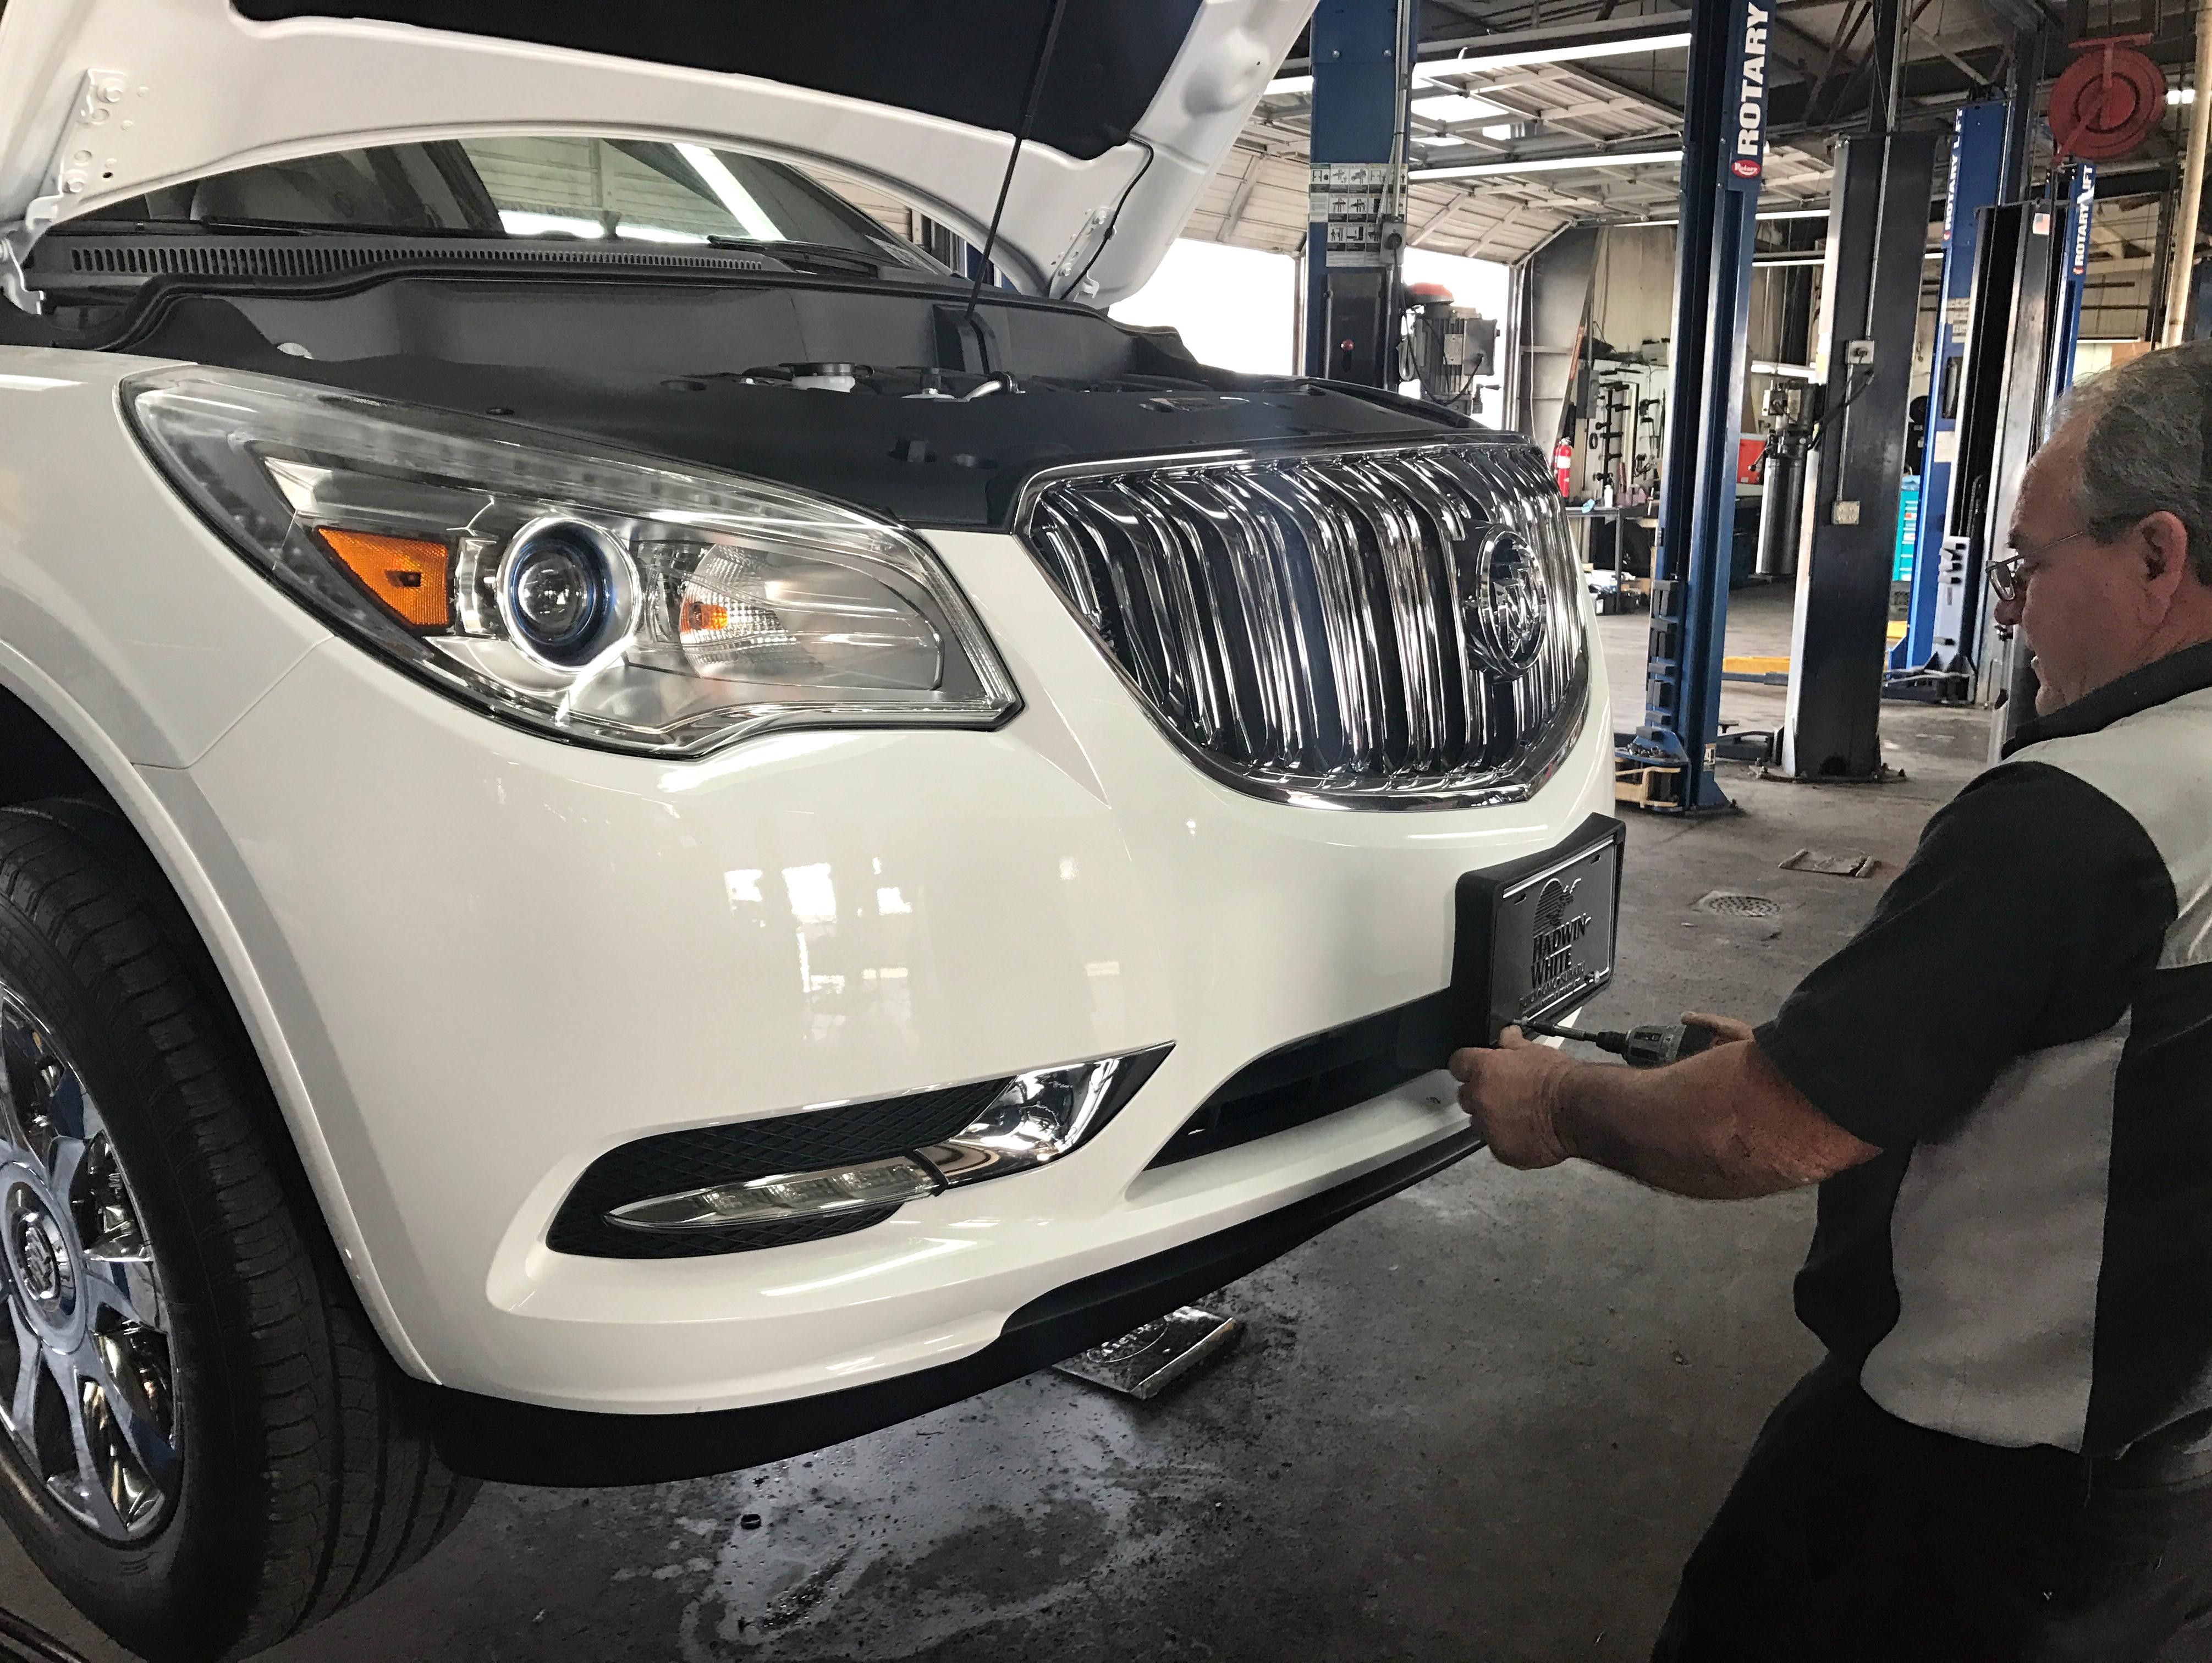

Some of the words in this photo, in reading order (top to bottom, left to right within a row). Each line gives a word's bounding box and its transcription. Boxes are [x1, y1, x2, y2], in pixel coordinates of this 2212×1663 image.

[1737, 2, 1768, 156] ROTARY
[1734, 162, 1758, 177] Rotary
[1945, 154, 1958, 230] ROTARY
[2075, 202, 2089, 266] ROTARY
[1531, 944, 1572, 989] WHITE
